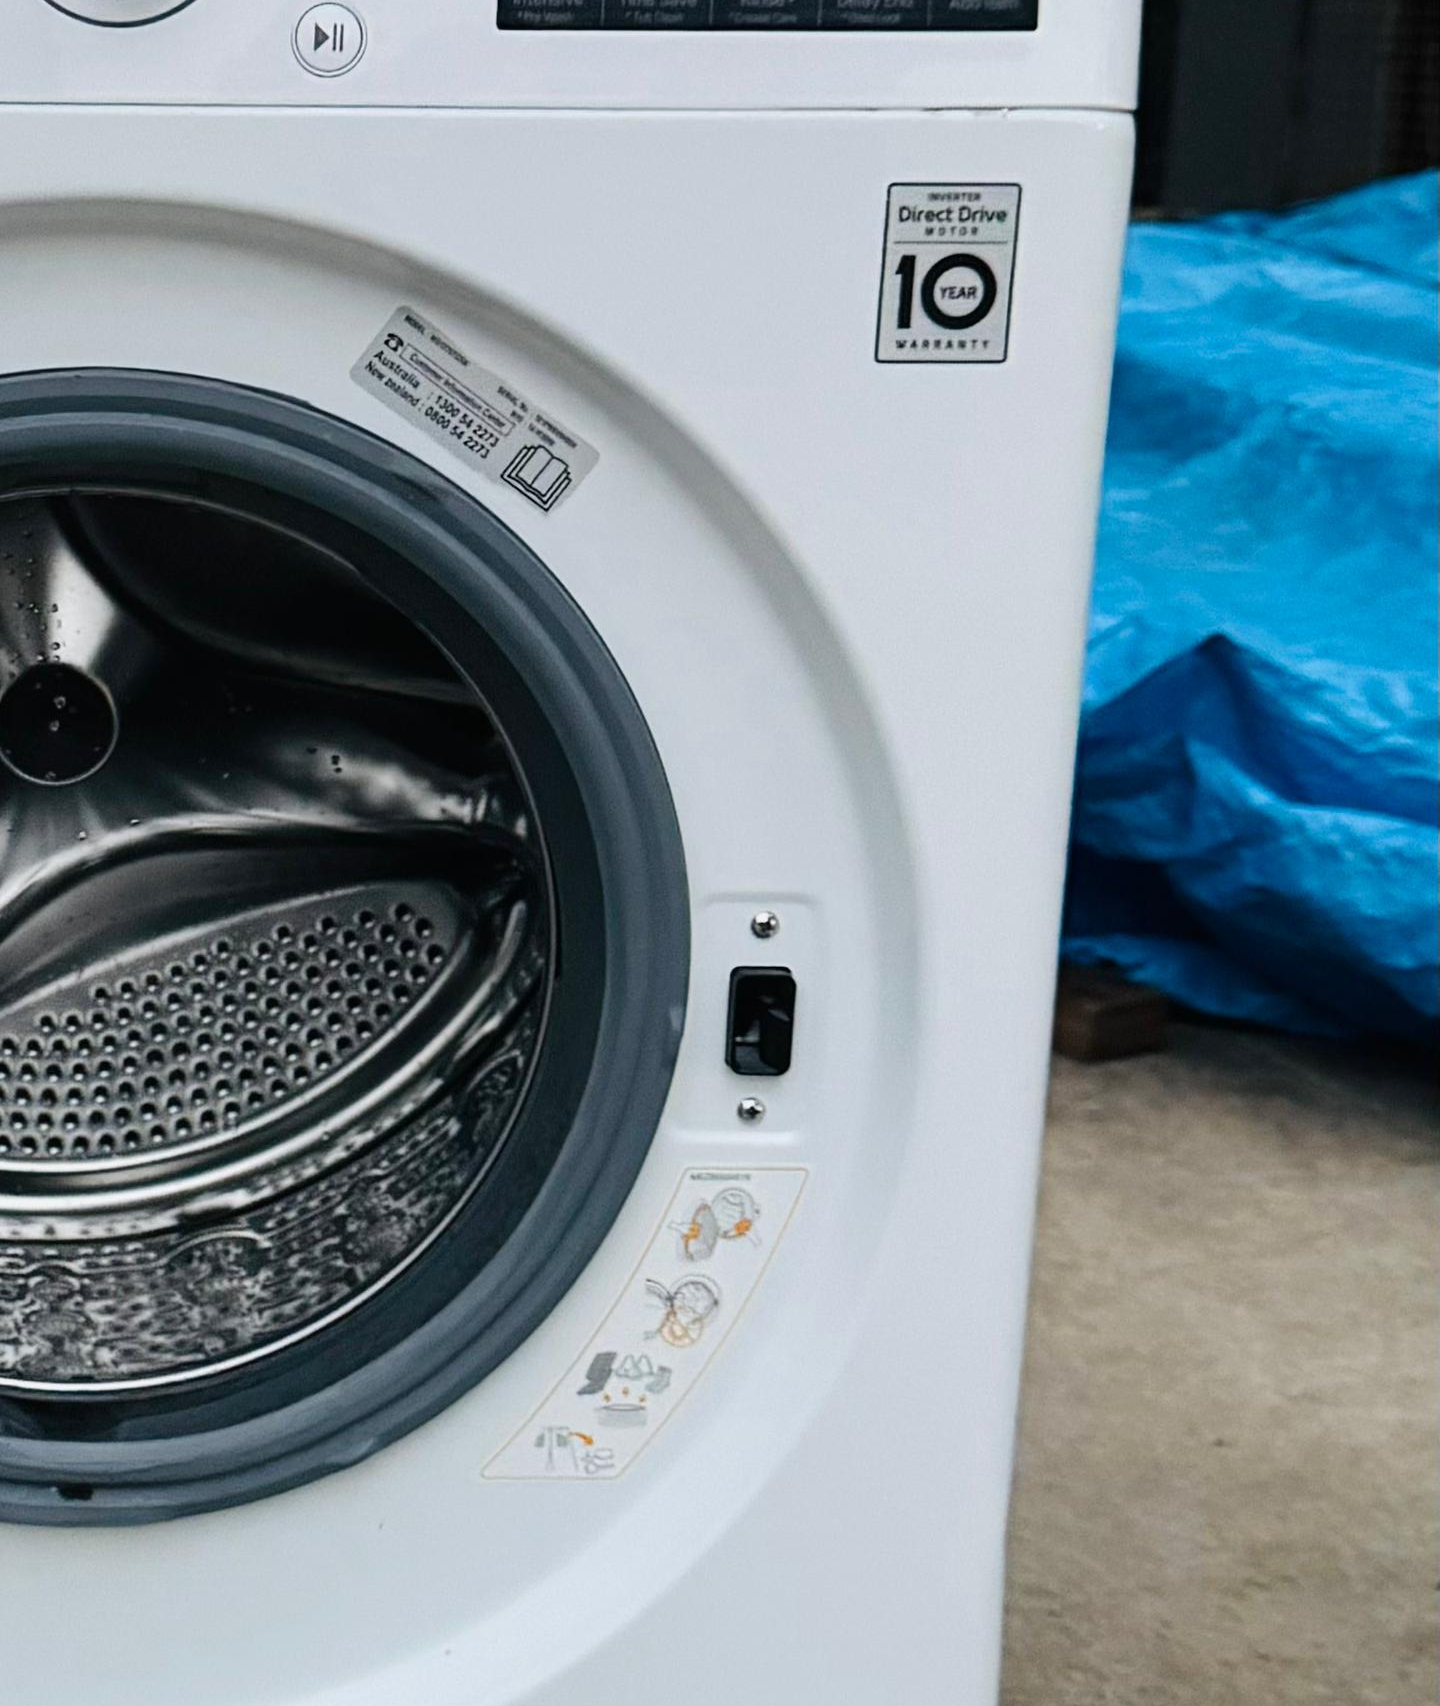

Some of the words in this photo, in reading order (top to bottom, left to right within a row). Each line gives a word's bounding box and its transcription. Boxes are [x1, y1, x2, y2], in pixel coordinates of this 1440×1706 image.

[899, 206, 953, 222] Direct
[959, 206, 1008, 223] Drive
[925, 227, 979, 236] MOTOR
[895, 253, 998, 330] 10
[940, 286, 978, 300] YEAR
[896, 340, 990, 349] WARRANTY
[373, 350, 420, 389] Australia
[436, 395, 460, 418] 1300
[459, 413, 474, 429] 54
[473, 424, 500, 448] 2273
[365, 361, 386, 381] New
[424, 406, 450, 429] 0800
[449, 425, 465, 440] 54
[463, 436, 491, 459] 2273
